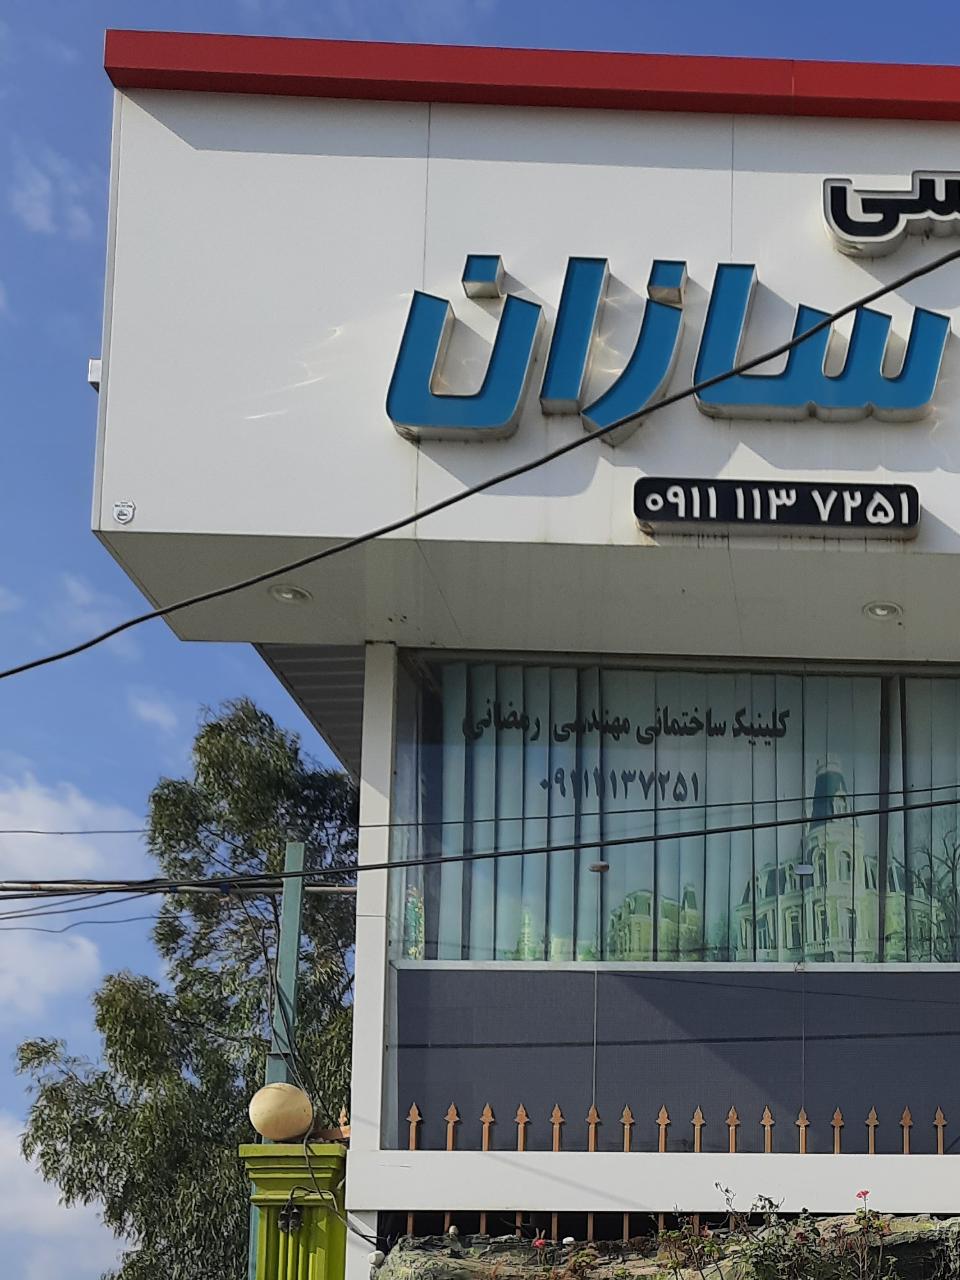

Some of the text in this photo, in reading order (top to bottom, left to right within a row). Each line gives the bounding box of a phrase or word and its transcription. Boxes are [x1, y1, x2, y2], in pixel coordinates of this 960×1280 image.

[386, 254, 951, 435] سازان
[645, 483, 911, 526] ۰۹۱۱ ۱۱۳ ۷۲۵۱
[462, 698, 541, 742] رمضانی
[636, 705, 727, 744] ساختمانی
[732, 707, 791, 746] کلینیک
